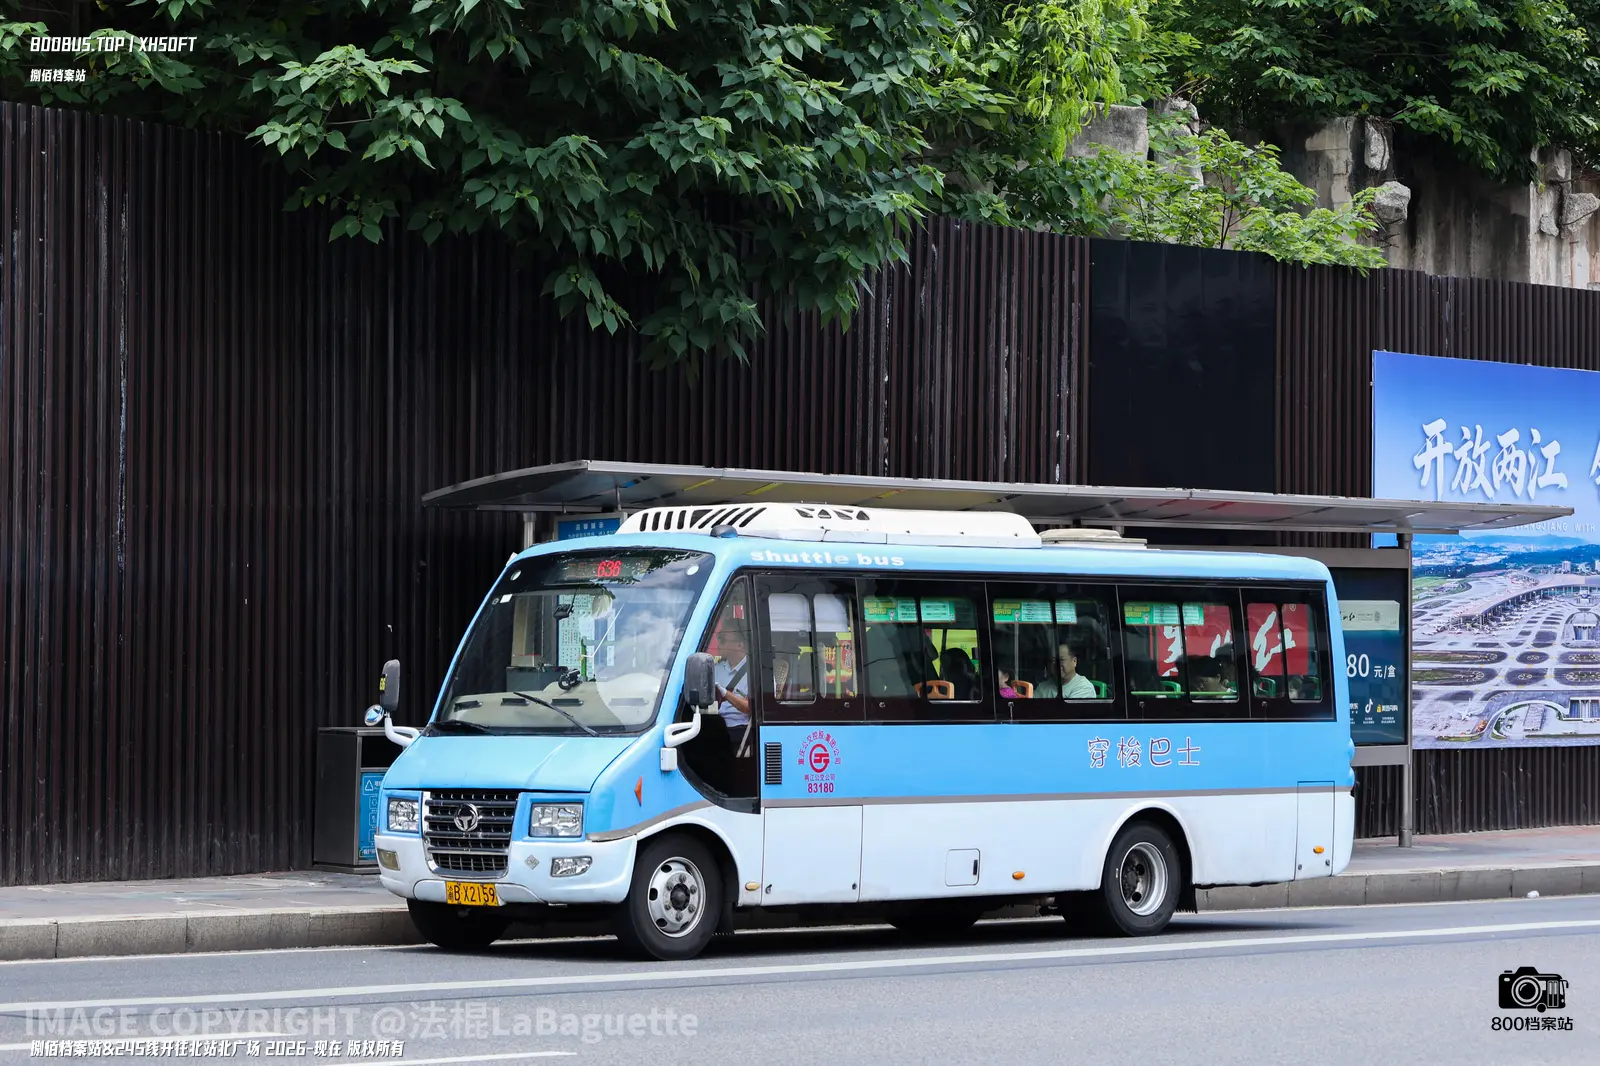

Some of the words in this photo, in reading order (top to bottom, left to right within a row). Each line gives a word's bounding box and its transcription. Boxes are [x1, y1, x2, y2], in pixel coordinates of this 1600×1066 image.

[1413, 418, 1569, 501] 开放两江
[1573, 523, 1596, 533] WITH
[750, 549, 850, 565] shuttle
[856, 552, 905, 567] bus
[597, 560, 623, 578] 636
[1373, 664, 1396, 679] 元/盒
[1087, 735, 1201, 769] 穿梭巴士
[807, 782, 835, 794] 83180
